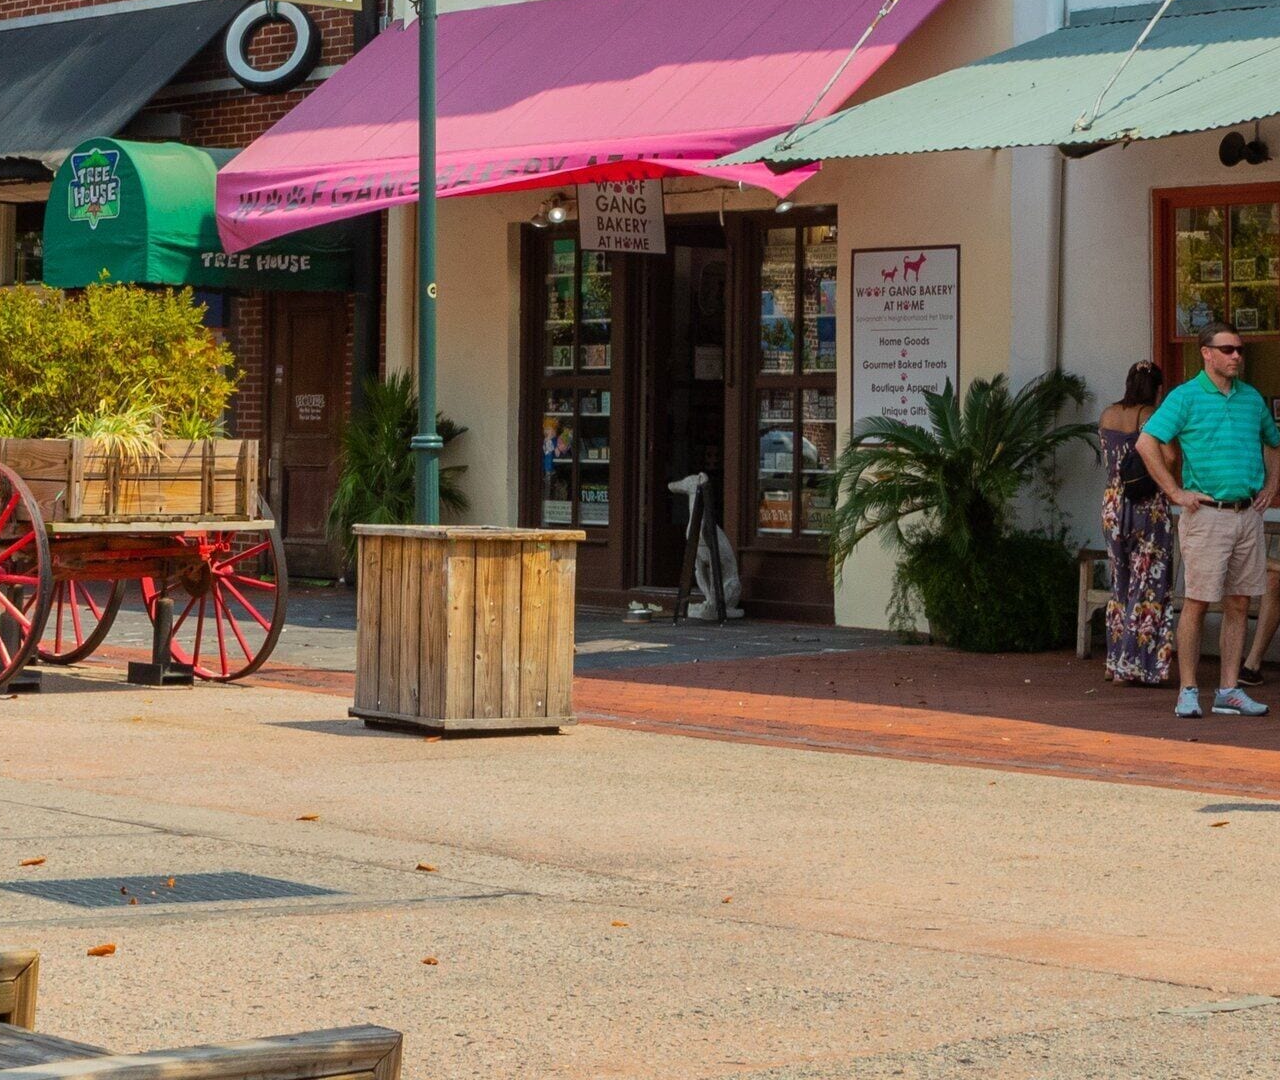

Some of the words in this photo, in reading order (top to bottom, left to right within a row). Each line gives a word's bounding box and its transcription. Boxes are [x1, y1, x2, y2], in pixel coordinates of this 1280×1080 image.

[77, 166, 110, 184] TREE
[331, 169, 419, 207] GANG
[73, 182, 117, 208] HOUSE
[596, 194, 646, 215] GANG
[596, 216, 648, 233] BAKERY
[598, 236, 611, 249] AT
[201, 252, 250, 269] TREE
[257, 255, 310, 273] HOUSE
[888, 285, 917, 297] GANG
[920, 284, 953, 296] BAKERY
[883, 300, 894, 312] AT
[879, 336, 902, 346] Home
[904, 335, 930, 346] Goods
[863, 360, 896, 370] Gourmet
[898, 360, 923, 369] Baked
[924, 360, 947, 369] Treats
[871, 384, 905, 394] Boutique
[906, 383, 938, 394] Apparel
[881, 406, 908, 417] Unique
[910, 406, 927, 416] Gifts
